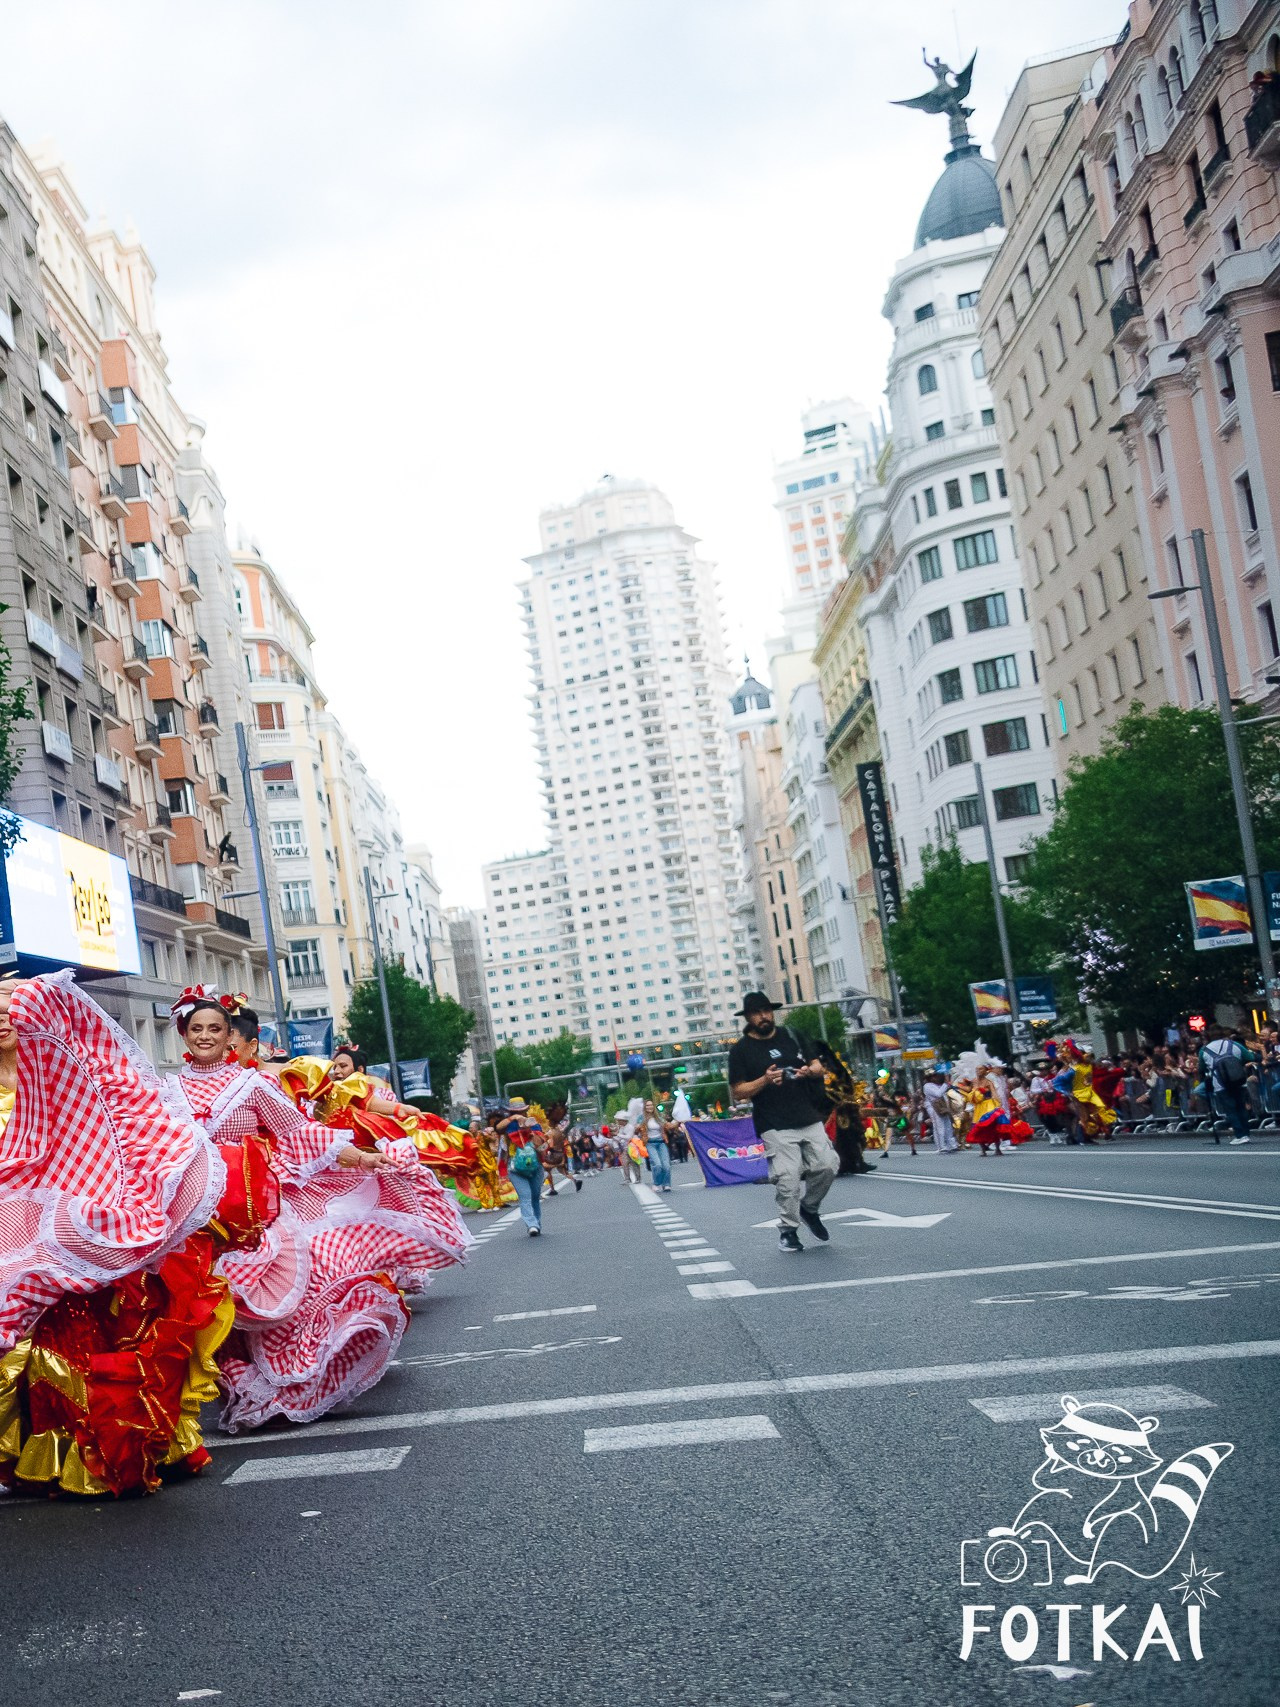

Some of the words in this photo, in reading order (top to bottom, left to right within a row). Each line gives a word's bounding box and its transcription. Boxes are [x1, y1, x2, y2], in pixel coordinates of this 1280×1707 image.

[864, 769, 889, 863] CATALONIA
[880, 870, 898, 924] PLAZA
[1012, 1021, 1025, 1035] P
[293, 1040, 324, 1049] NACIONAL
